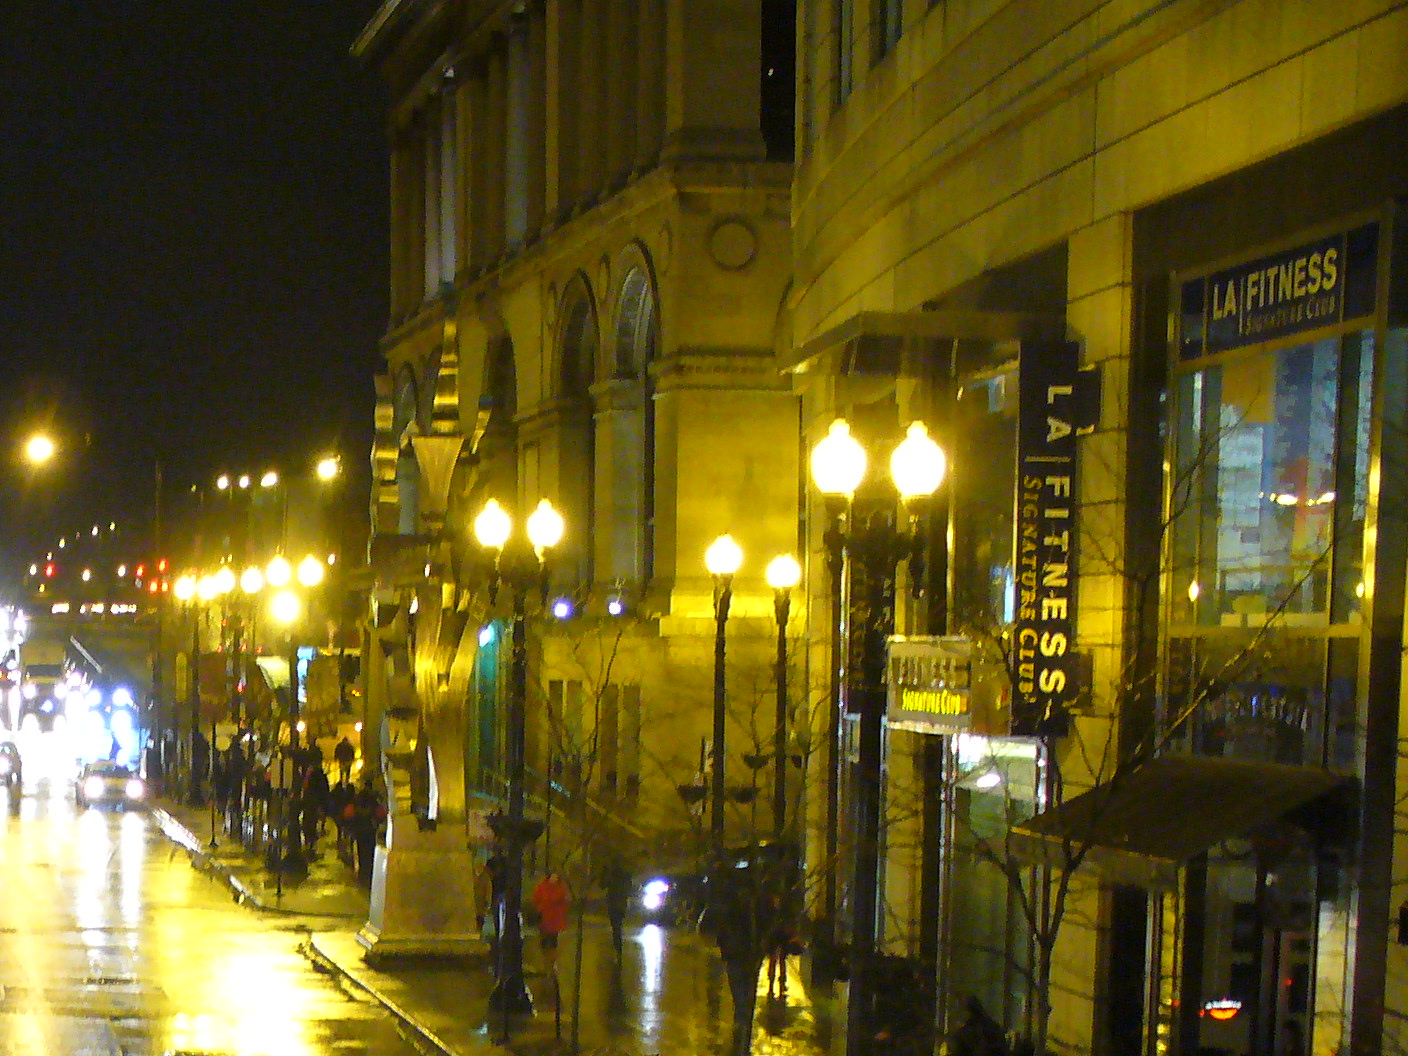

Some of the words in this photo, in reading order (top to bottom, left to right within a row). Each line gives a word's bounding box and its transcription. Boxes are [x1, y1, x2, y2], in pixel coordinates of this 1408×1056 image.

[1212, 279, 1237, 321] LA
[1247, 247, 1338, 313] FITNESS
[1046, 385, 1073, 442] LA
[1039, 475, 1071, 694] FITNESS
[1018, 627, 1038, 694] CLUB
